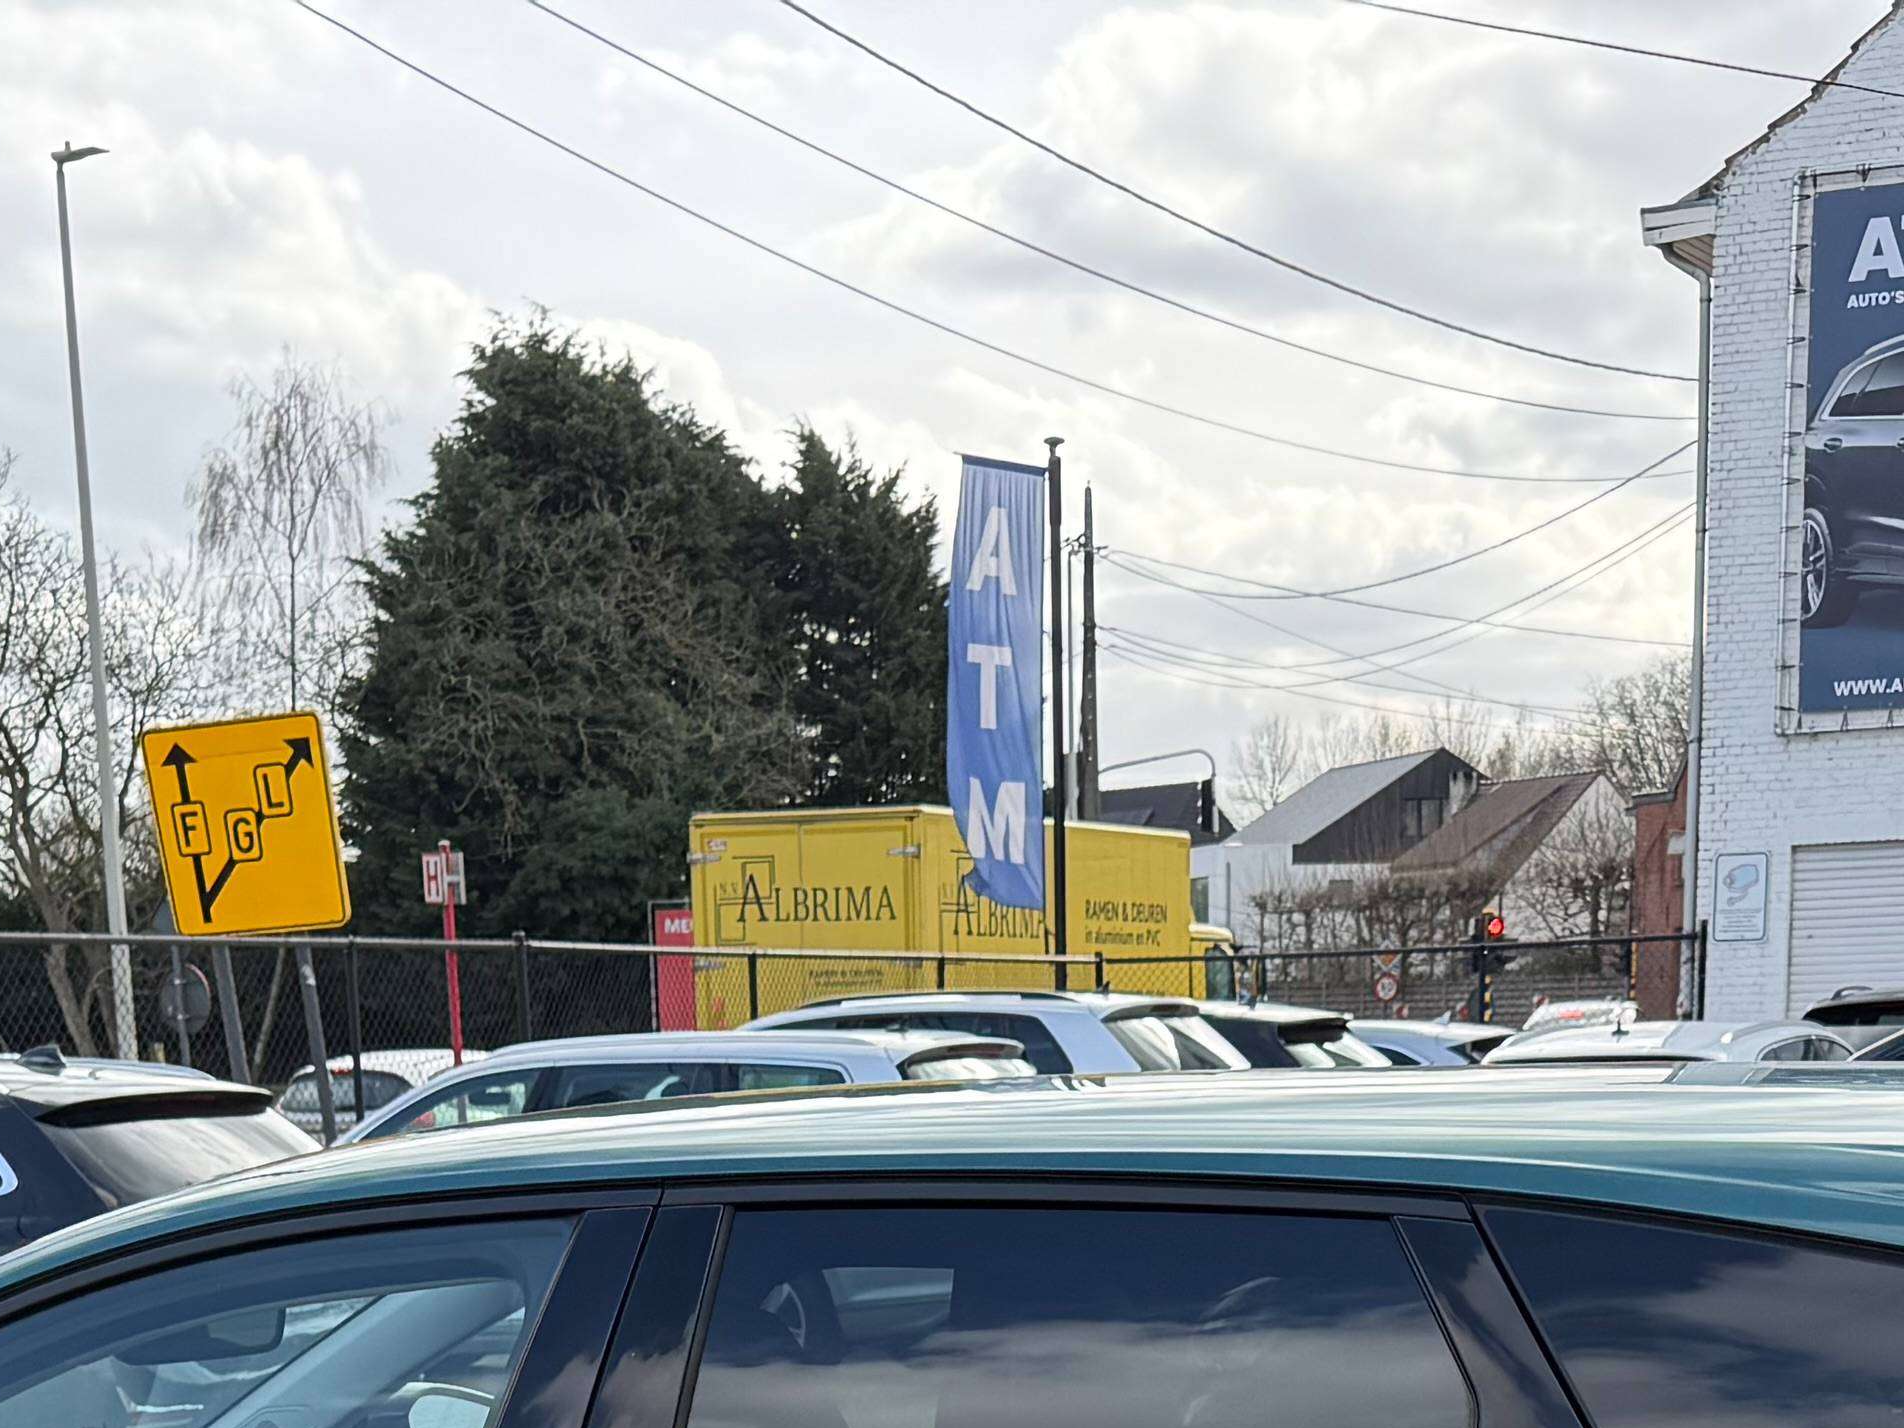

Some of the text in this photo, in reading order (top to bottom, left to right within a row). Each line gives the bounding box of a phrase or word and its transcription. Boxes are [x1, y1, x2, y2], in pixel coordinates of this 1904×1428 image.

[1846, 289, 1904, 309] AUTO'S
[965, 506, 1027, 866] ATM
[261, 771, 285, 807] L
[181, 811, 199, 848] F
[232, 820, 255, 854] G
[737, 874, 897, 923] ALBRIMA
[664, 918, 693, 934] ME
